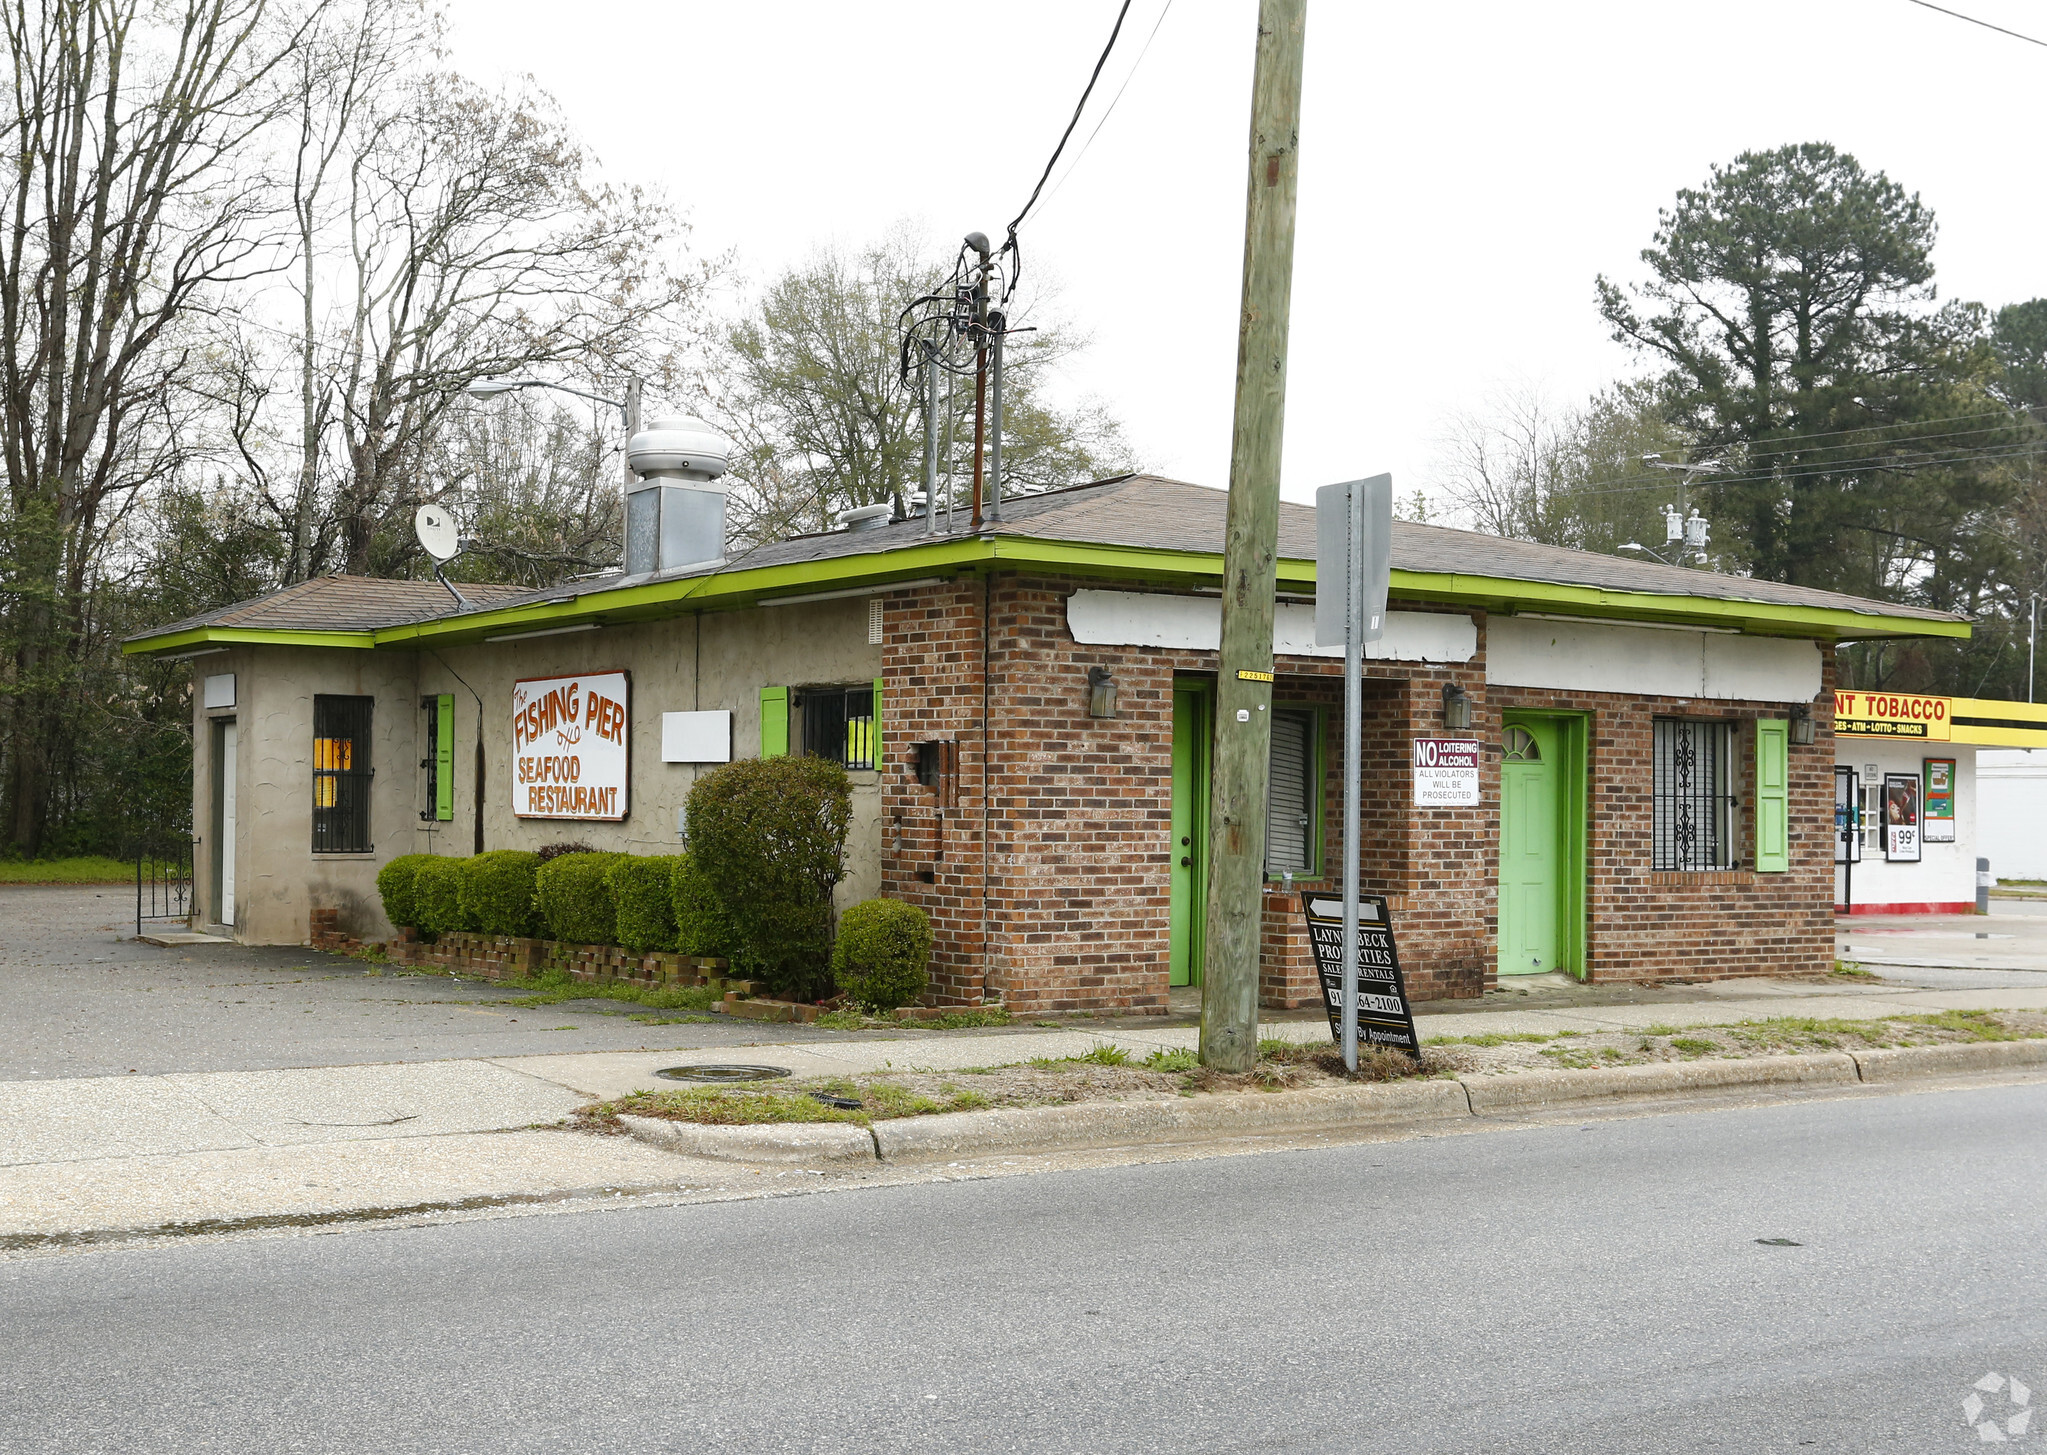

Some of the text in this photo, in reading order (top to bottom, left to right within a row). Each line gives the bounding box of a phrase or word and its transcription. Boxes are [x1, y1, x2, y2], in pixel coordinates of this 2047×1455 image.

[514, 688, 528, 711] The
[1865, 696, 1945, 721] TOBACCO
[514, 682, 625, 754] FISHING PIER
[1852, 721, 1866, 732] ATM
[1871, 722, 1892, 733] LOTTO
[1896, 724, 1923, 734] SNACKS
[1416, 741, 1477, 767] NO LOITERING
[1438, 756, 1474, 766] ALCOHOL
[518, 755, 581, 784] SEAFOOD
[1419, 770, 1475, 778] ALL VIOLATORS
[1422, 790, 1472, 799] PROSECUTED
[1432, 780, 1462, 789] WILL BE
[528, 785, 618, 815] RESTAURANT
[1313, 928, 1389, 947] LAYN BECK
[1318, 943, 1392, 965] PRORTIES
[1323, 963, 1395, 980] SALE RENTALS
[1330, 990, 1401, 1012] 9164-2100
[1357, 1026, 1367, 1041] By
[1369, 1028, 1411, 1044] Appointment
